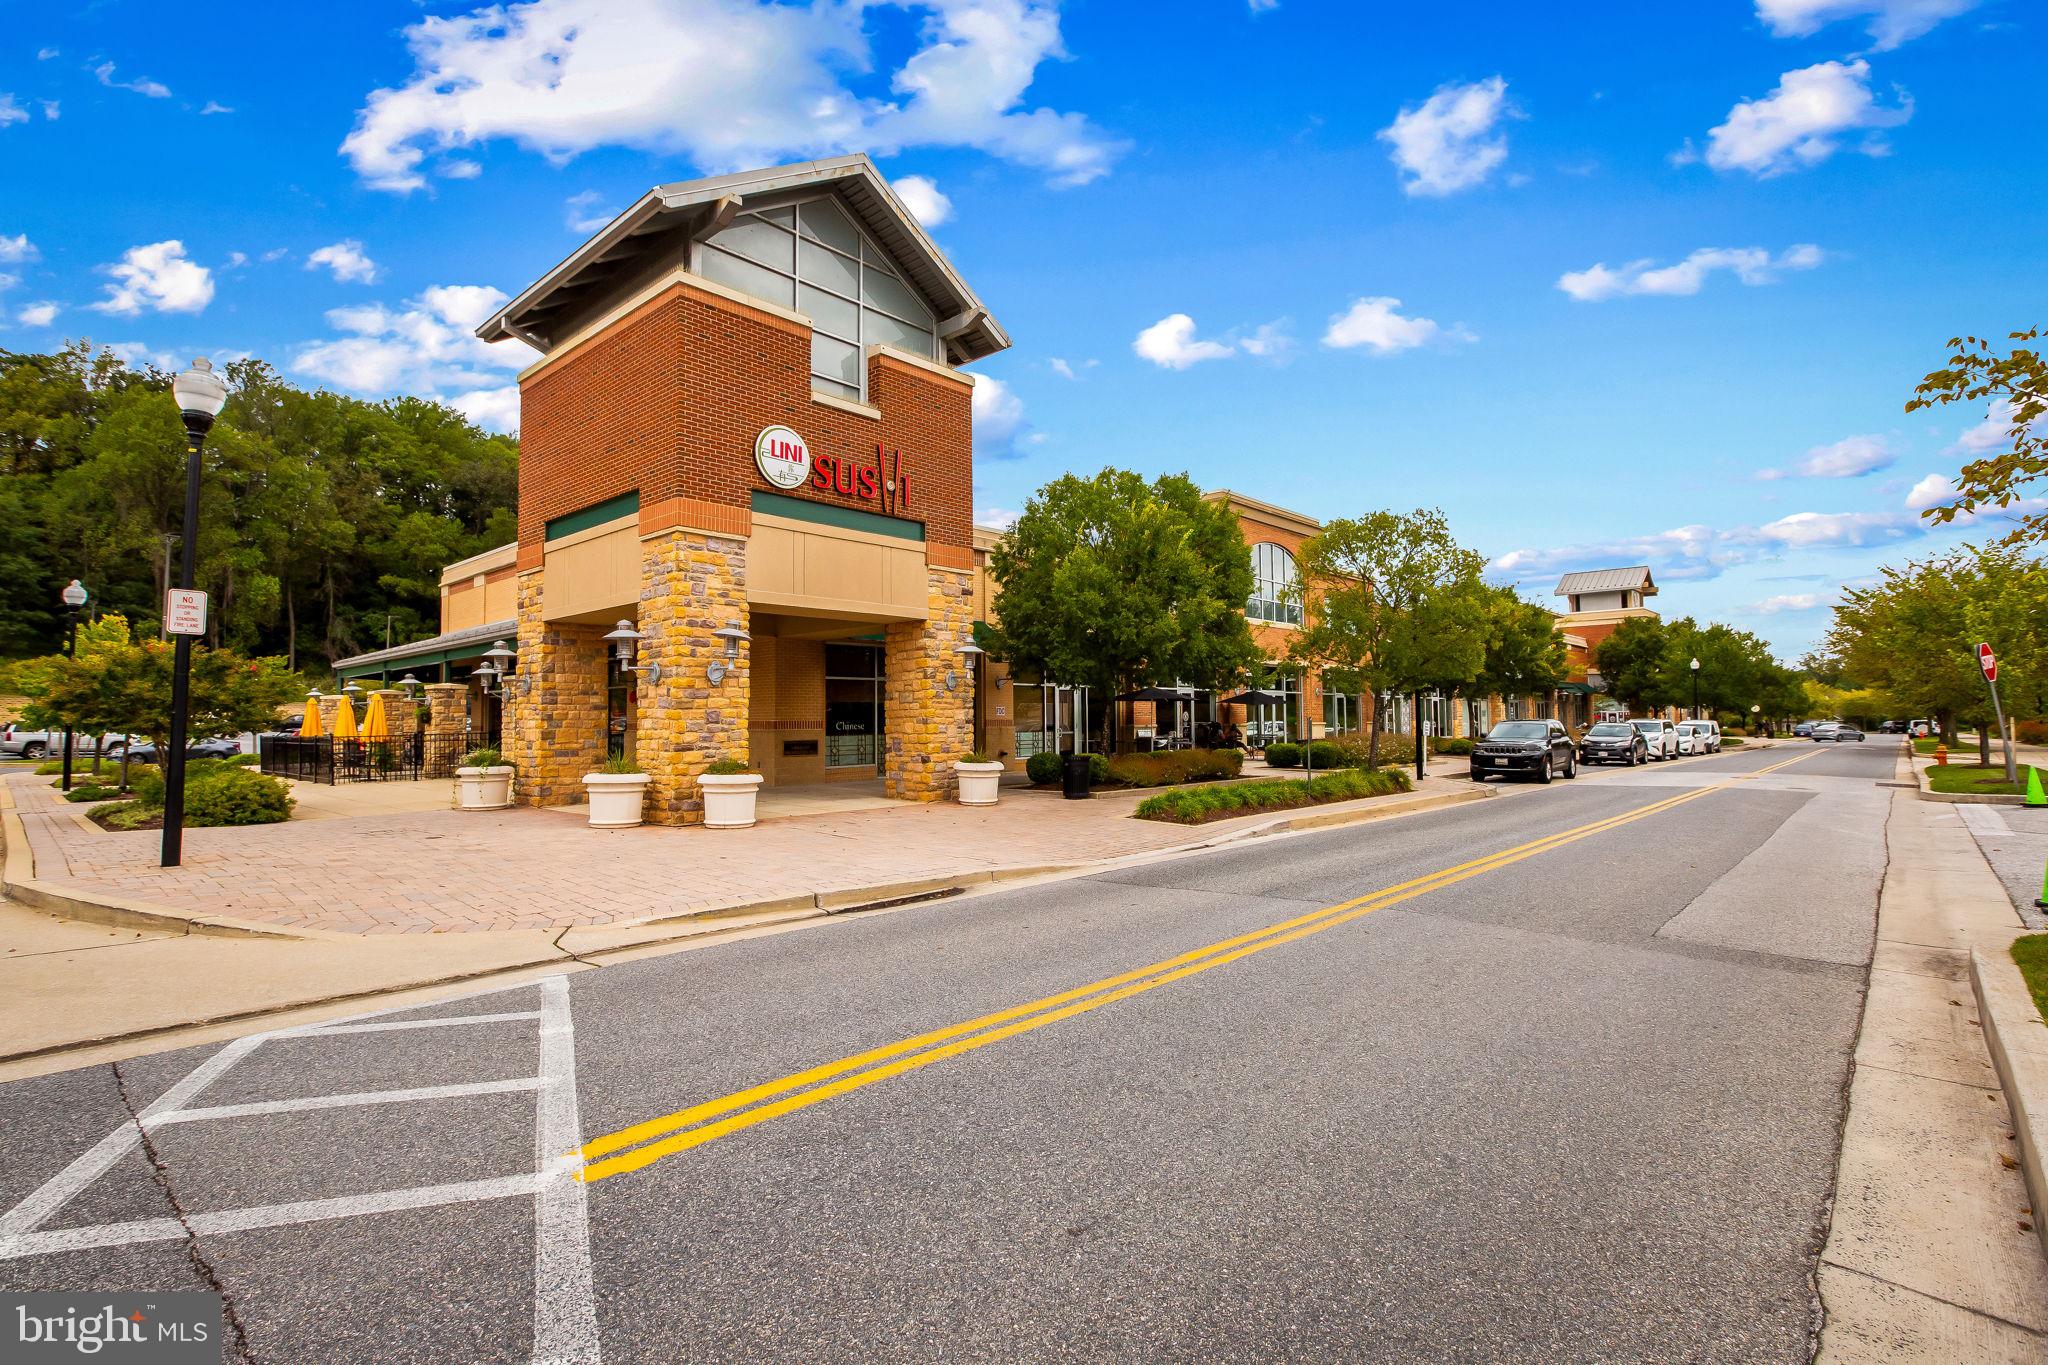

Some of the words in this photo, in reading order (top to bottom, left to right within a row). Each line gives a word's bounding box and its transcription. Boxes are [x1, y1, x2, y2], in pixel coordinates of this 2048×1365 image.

[770, 438, 803, 464] LINI
[182, 596, 194, 604] NO
[1981, 655, 1995, 670] STOP
[835, 721, 865, 731] Chinese
